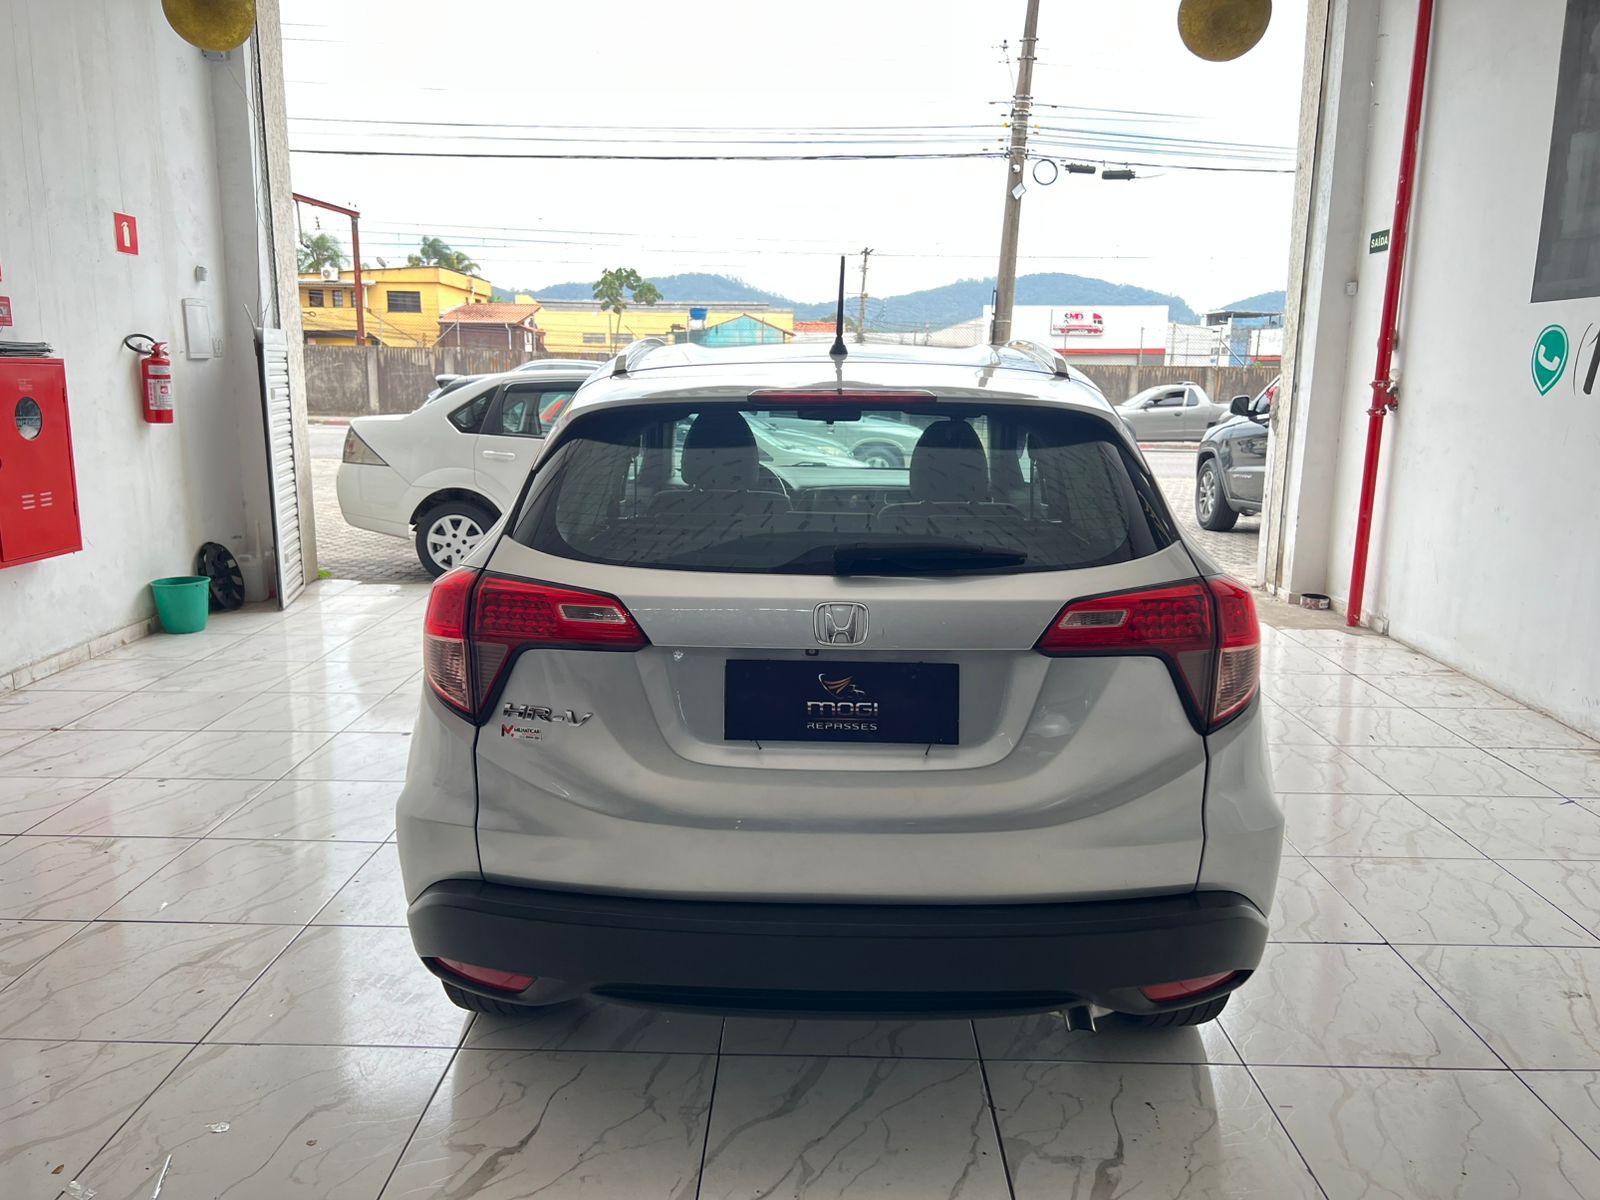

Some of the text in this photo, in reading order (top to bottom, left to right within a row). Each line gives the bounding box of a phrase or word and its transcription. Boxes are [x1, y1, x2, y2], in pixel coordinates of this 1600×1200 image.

[1370, 235, 1389, 248] SAÍDA
[807, 701, 878, 712] MOGI
[503, 702, 594, 727] HR-V
[807, 722, 878, 731] REPASSES
